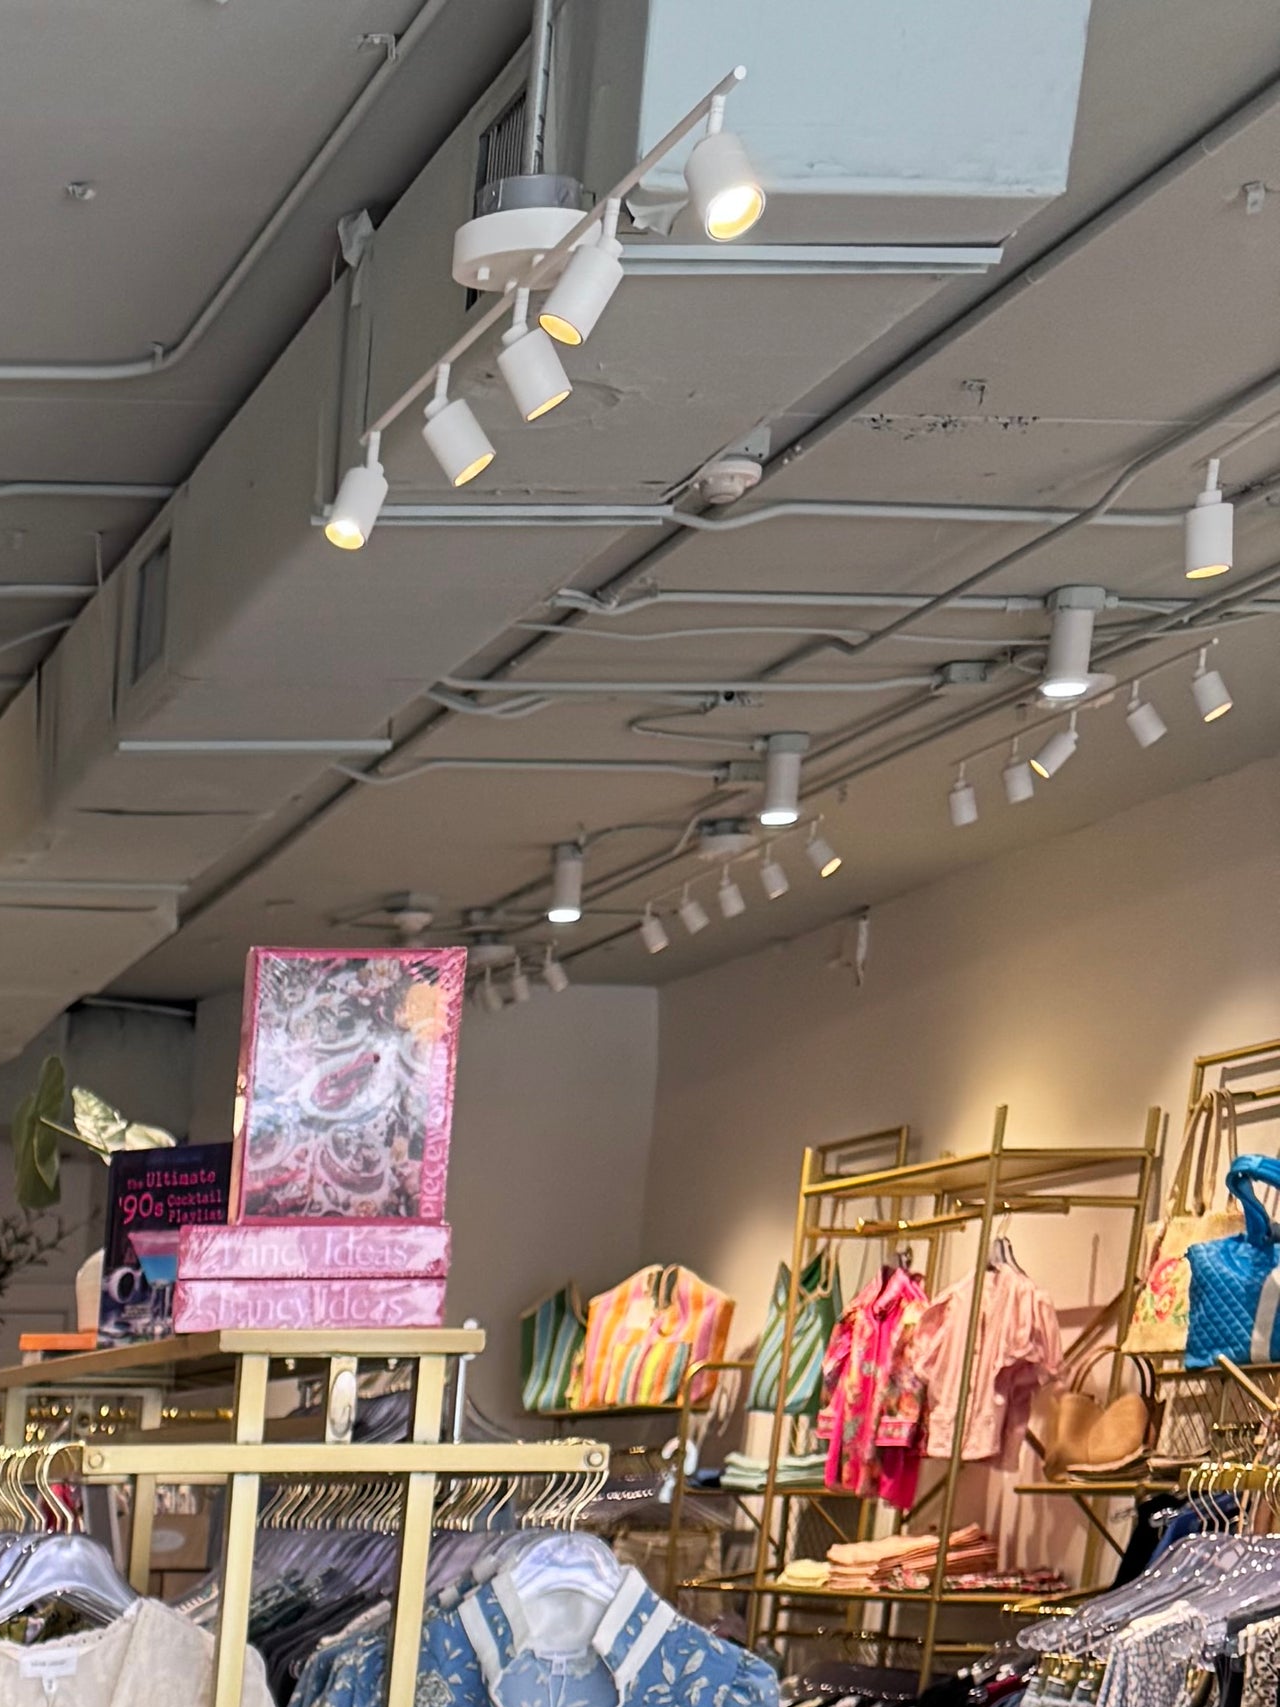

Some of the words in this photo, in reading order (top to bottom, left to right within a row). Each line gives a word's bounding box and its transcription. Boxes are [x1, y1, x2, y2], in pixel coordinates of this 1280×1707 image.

[146, 1168, 216, 1189] Ultimate
[119, 1192, 164, 1225] '90s
[167, 1189, 222, 1208] Cocktail
[168, 1208, 223, 1224] Playlist
[324, 1231, 408, 1268] Ideas
[320, 1284, 404, 1320] Ideas
